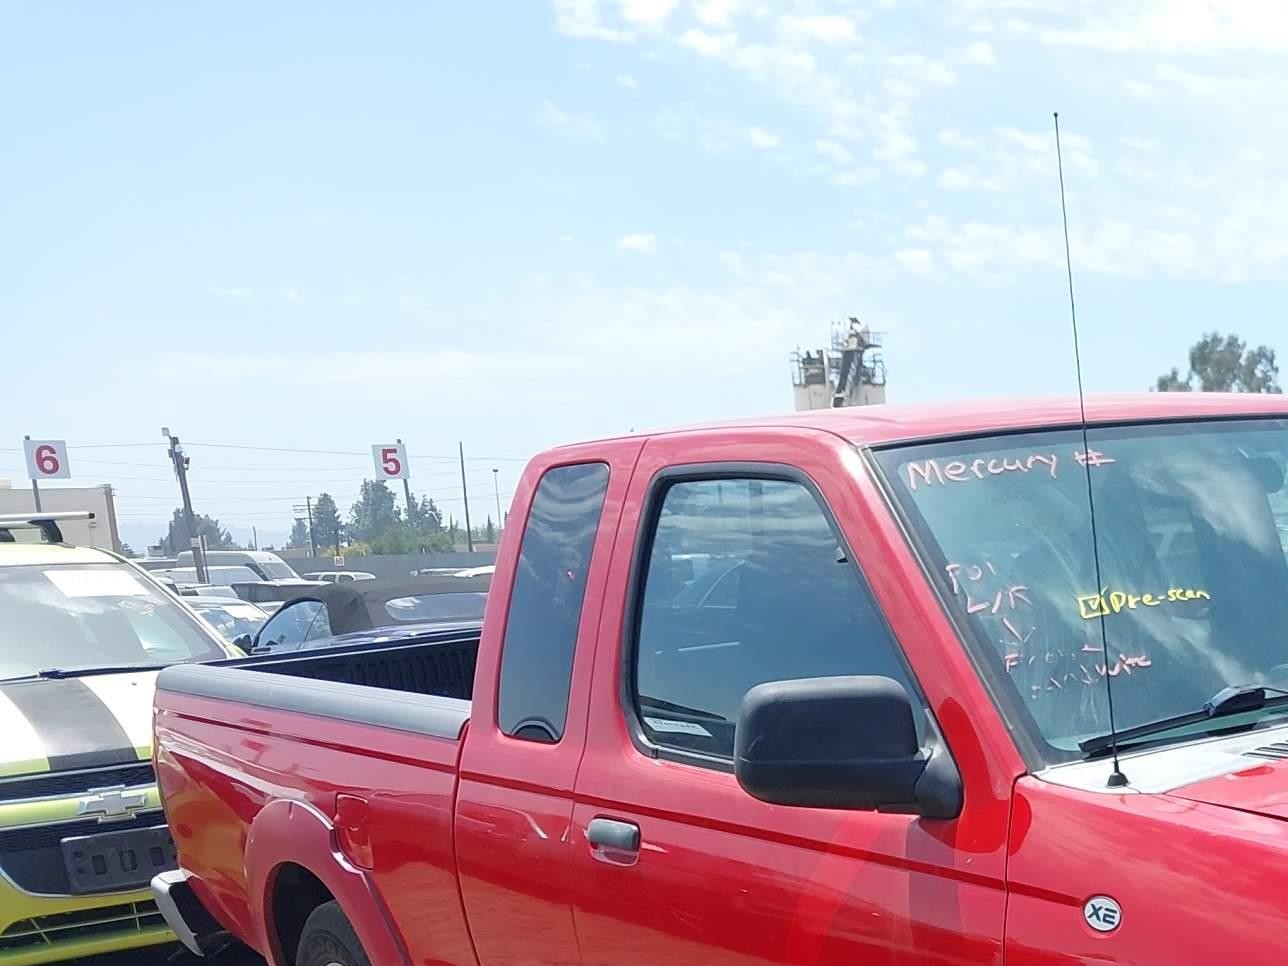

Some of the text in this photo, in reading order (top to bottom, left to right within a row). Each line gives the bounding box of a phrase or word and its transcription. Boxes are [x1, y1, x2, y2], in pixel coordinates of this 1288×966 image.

[36, 445, 59, 474] 6
[381, 448, 401, 475] 5
[906, 453, 1057, 491] Mercury
[1087, 903, 1118, 926] XE
